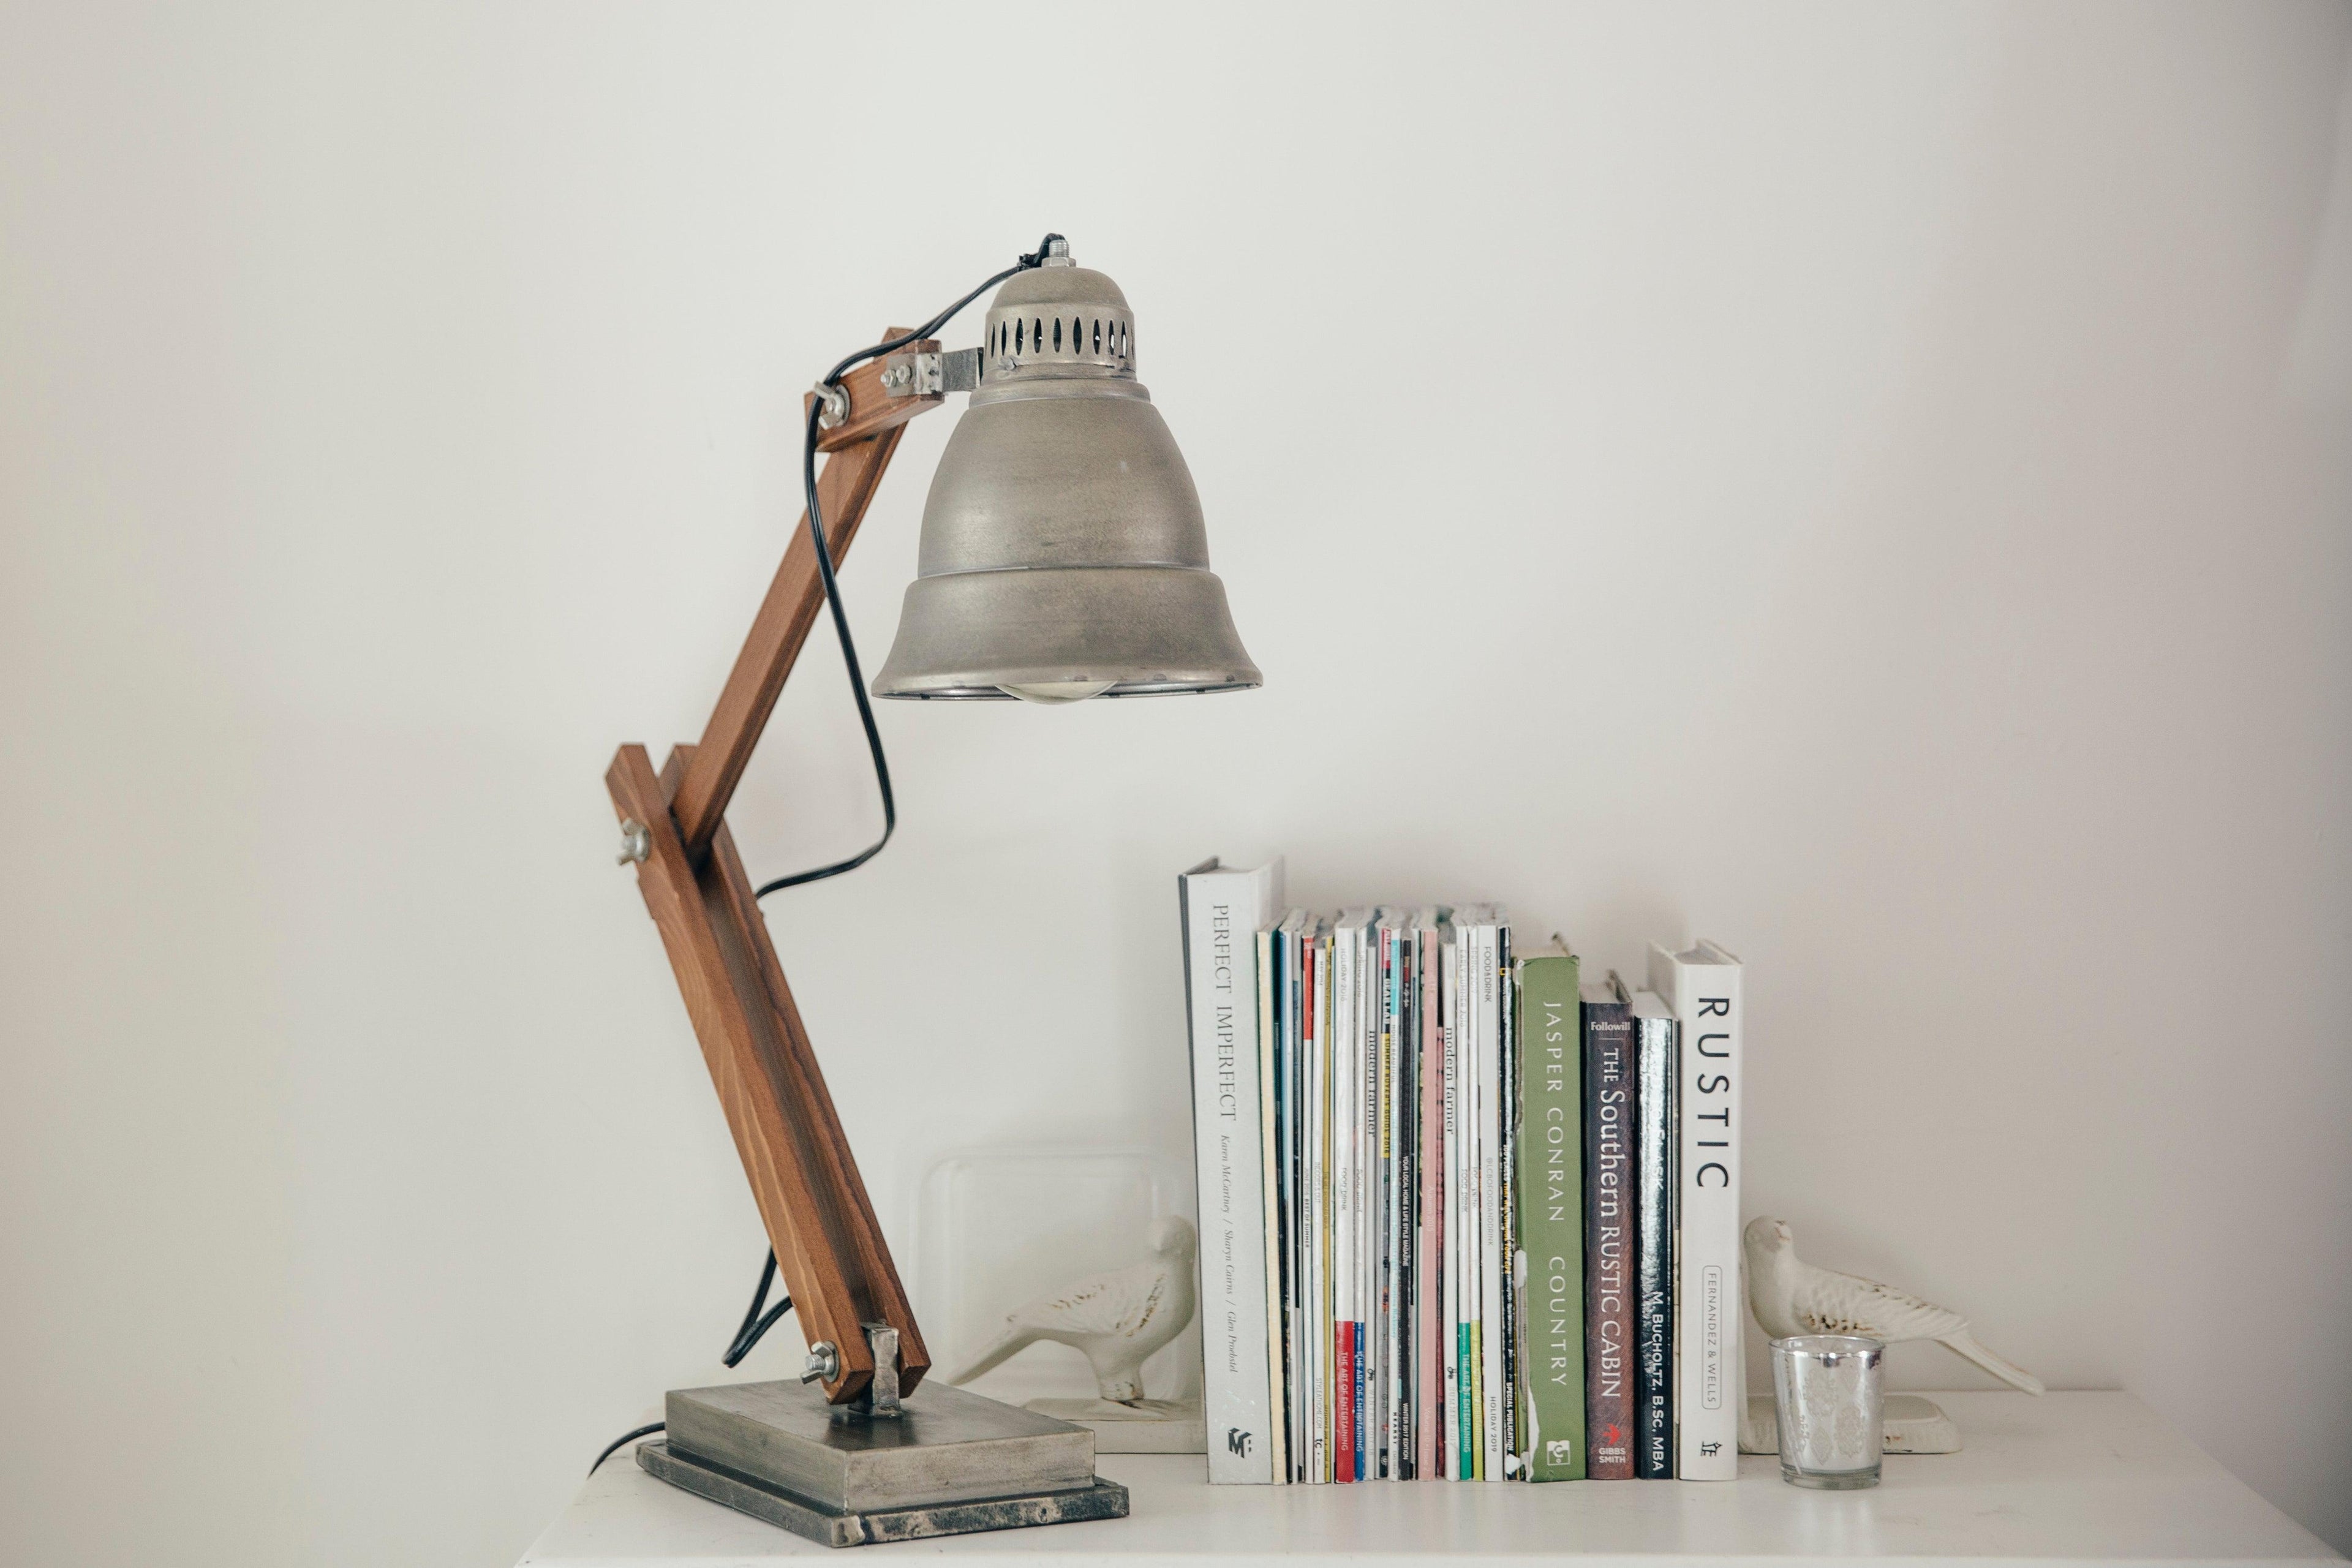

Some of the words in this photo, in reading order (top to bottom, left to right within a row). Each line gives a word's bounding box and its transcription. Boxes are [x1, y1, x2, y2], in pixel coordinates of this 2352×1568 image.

[1213, 904, 1232, 994] PERFECT
[1544, 1001, 1562, 1092] JASPER
[1591, 1022, 1630, 1031] Followill
[1216, 1005, 1236, 1121] IMPERFECT
[1368, 1030, 1377, 1084] modern
[1446, 1027, 1456, 1081] modern
[1603, 1048, 1619, 1084] THE
[1446, 1087, 1456, 1135] farmer
[1696, 997, 1730, 1188] RUSTIC
[1221, 1134, 1231, 1161] Karen
[1547, 1107, 1565, 1221] CONRAN
[1600, 1090, 1626, 1218] Southern
[1651, 1129, 1665, 1191] FLASK
[1221, 1165, 1231, 1213] McCartney
[1223, 1229, 1234, 1262] Sharyn
[1600, 1226, 1621, 1313] RUSTIC
[1226, 1264, 1235, 1295] Cairns
[1652, 1291, 1664, 1310] M.
[1227, 1311, 1237, 1332] Glen
[1549, 1256, 1567, 1386] COUNTRY
[1707, 1273, 1716, 1346] FERNANDEZ
[1227, 1334, 1238, 1373] Proebstel
[1600, 1320, 1621, 1398] CABIN
[1651, 1314, 1664, 1390] BUCHOLTZ,
[1707, 1350, 1716, 1359] &
[1341, 1384, 1348, 1395] OF
[1356, 1384, 1363, 1397] OF
[1707, 1363, 1716, 1402] WELLS
[1652, 1437, 1664, 1471] MBA
